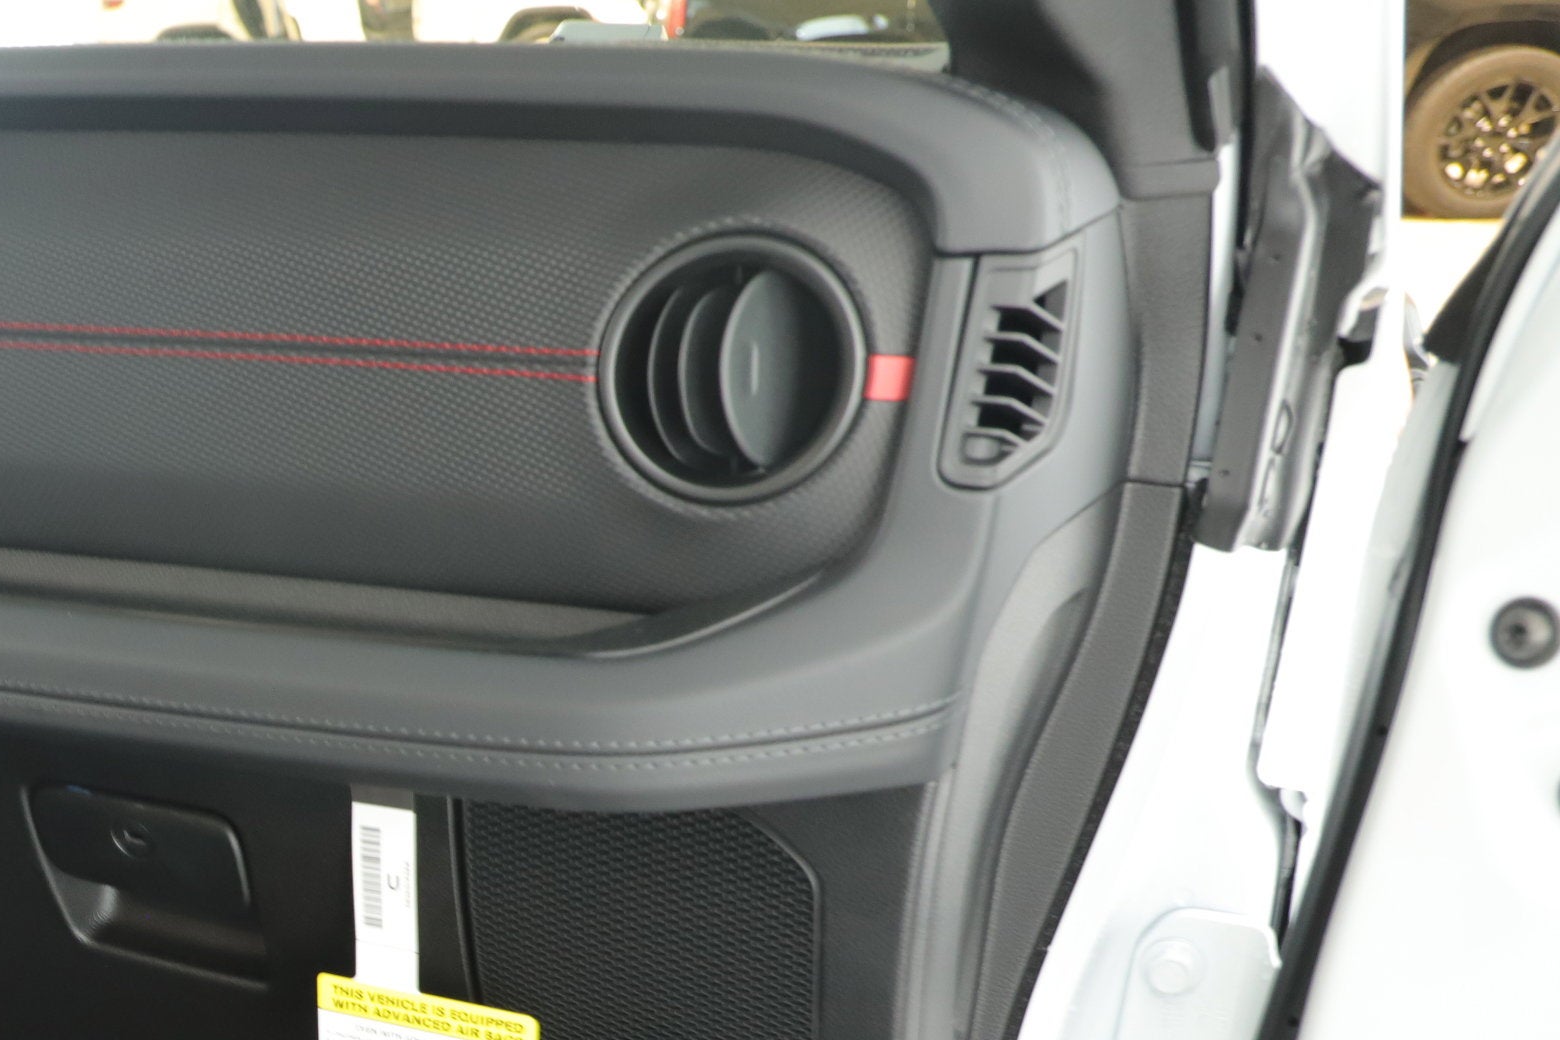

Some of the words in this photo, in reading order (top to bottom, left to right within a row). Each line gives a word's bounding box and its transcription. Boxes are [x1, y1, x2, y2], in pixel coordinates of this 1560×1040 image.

[333, 984, 363, 1000] THIS
[368, 991, 427, 1014] VEHICLE
[433, 1005, 445, 1017] IS
[450, 1010, 524, 1034] EQUIPPED
[333, 998, 368, 1013] WITH
[374, 1007, 451, 1032] ADVANCED
[458, 1025, 479, 1038] AIR
